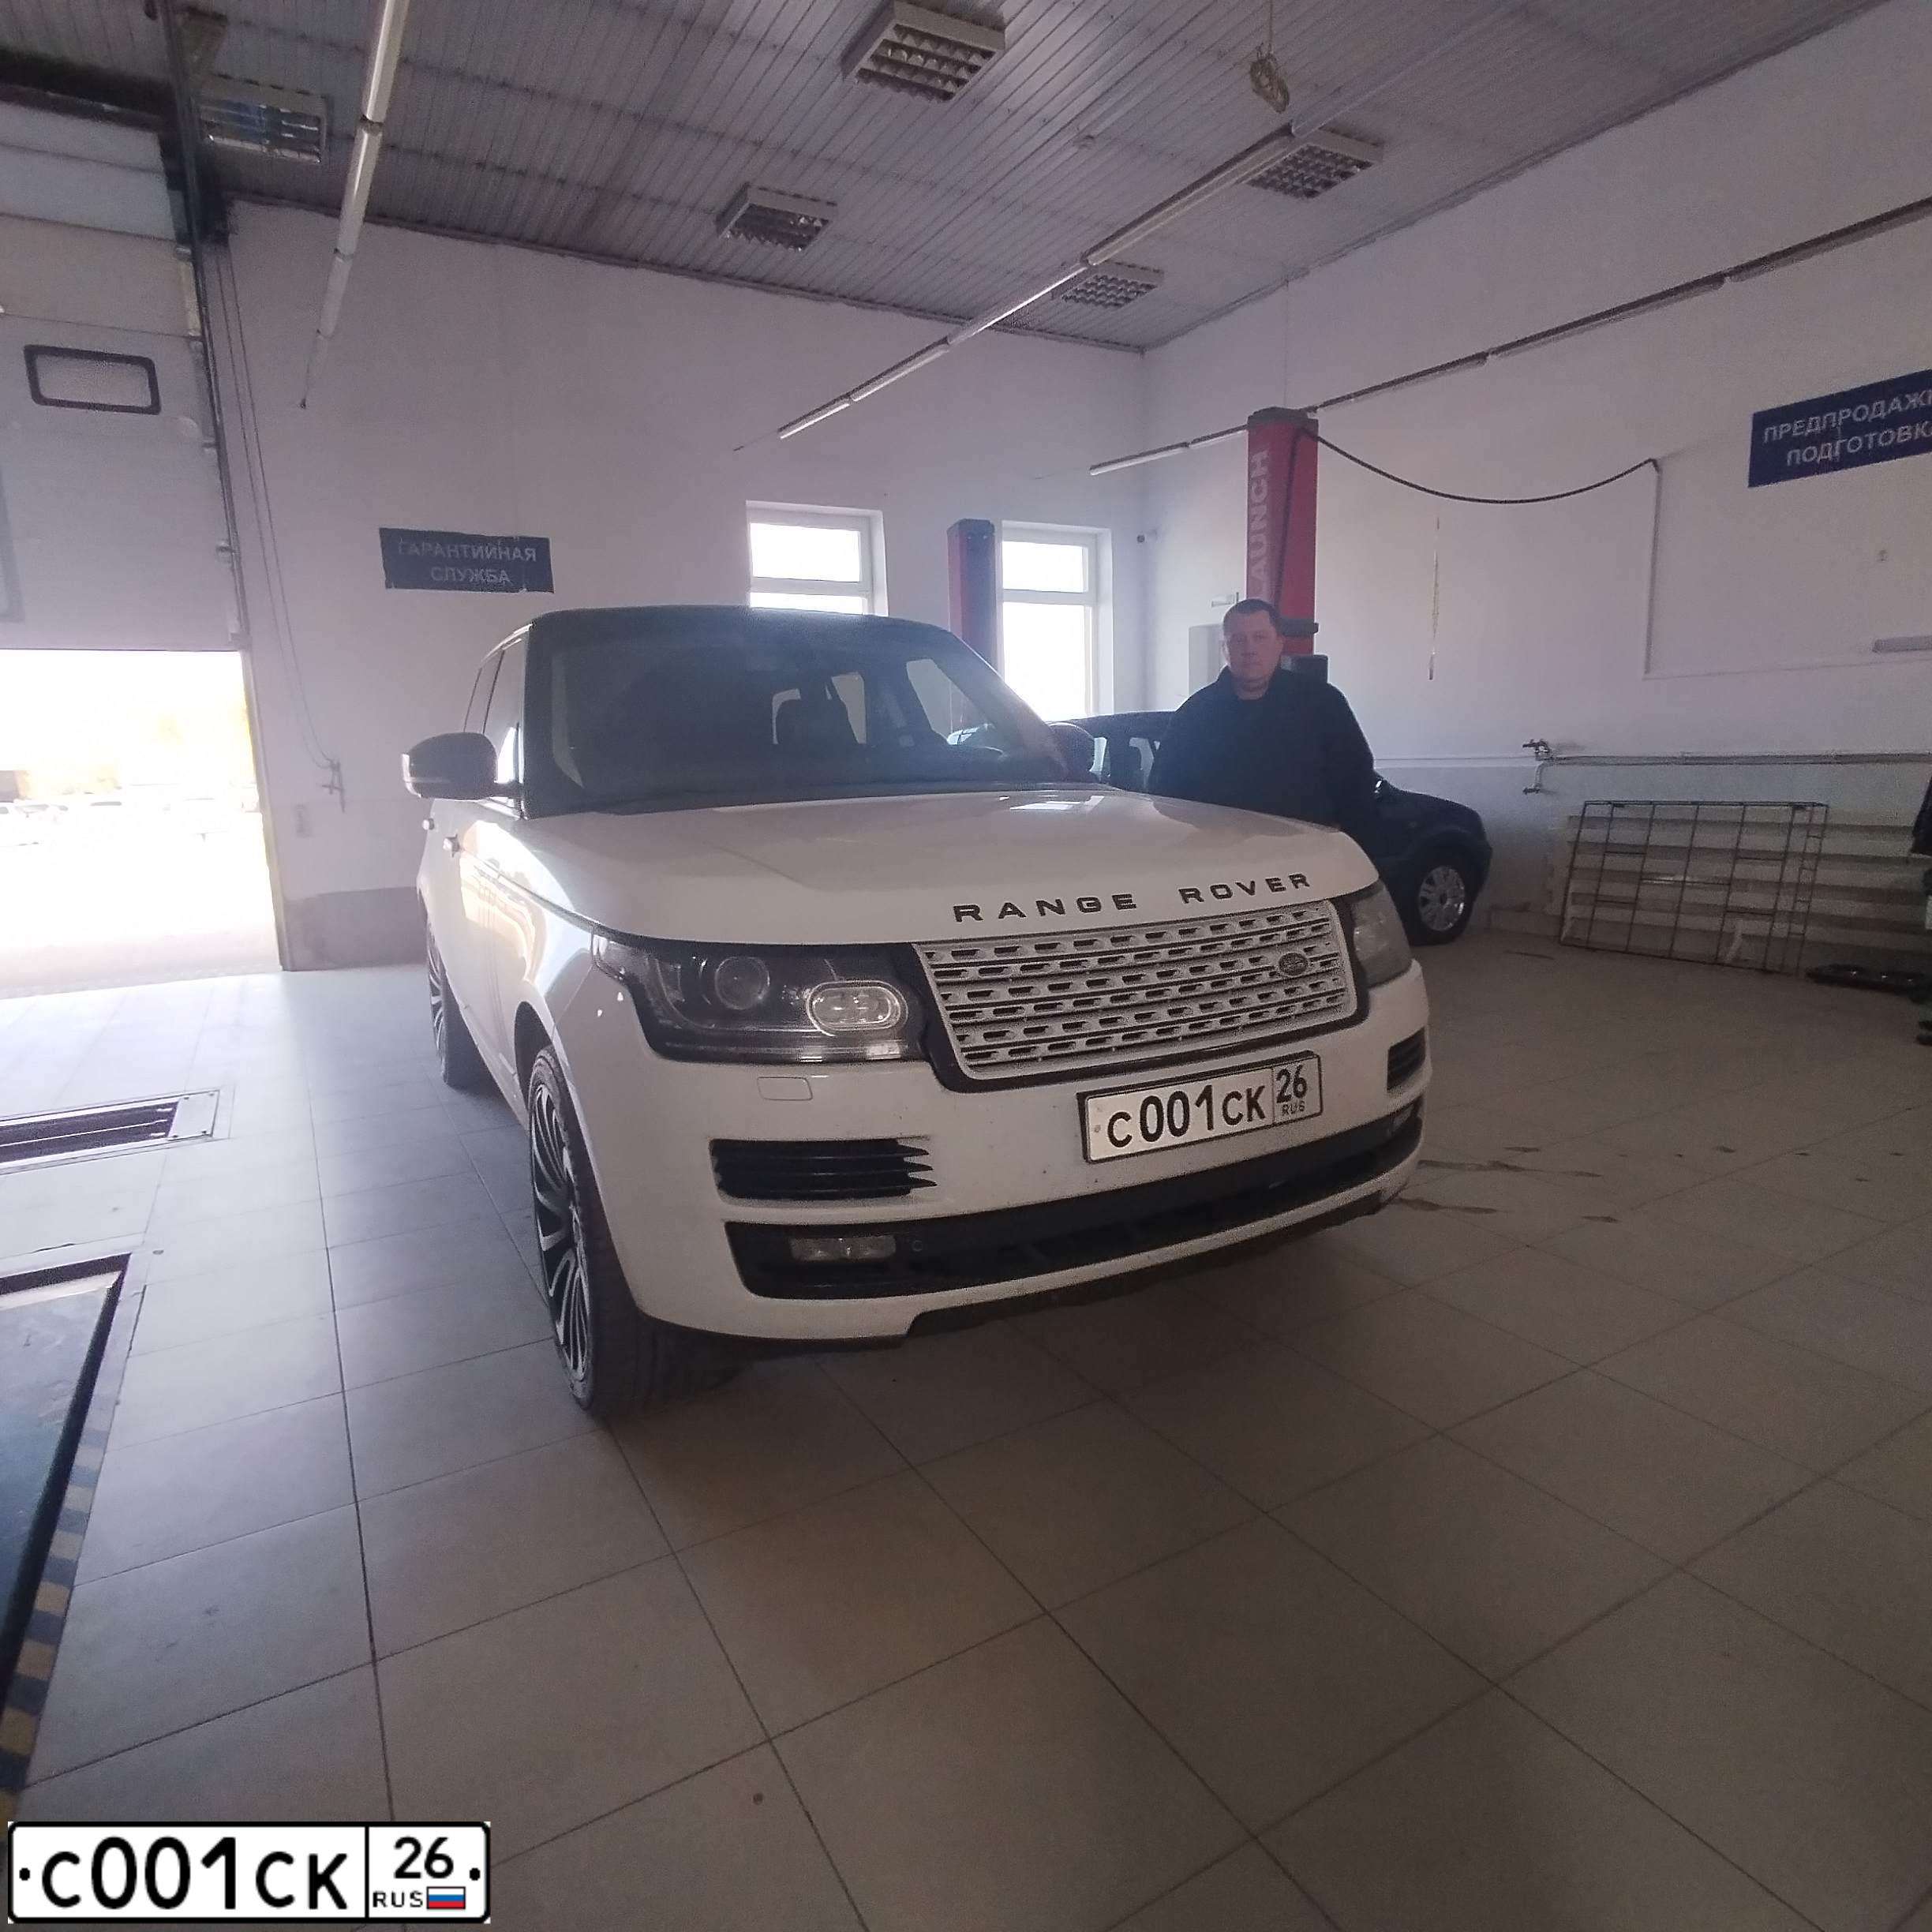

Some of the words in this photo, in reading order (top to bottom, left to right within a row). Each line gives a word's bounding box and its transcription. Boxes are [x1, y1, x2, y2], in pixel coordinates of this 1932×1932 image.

[1787, 420, 1932, 466] ПОДГОТОВК
[431, 567, 511, 585] СЛУЖБА
[953, 893, 1136, 922] RANGE
[1178, 873, 1310, 904] ROVER
[1276, 1065, 1308, 1103] 26
[1282, 1100, 1305, 1117] RUS
